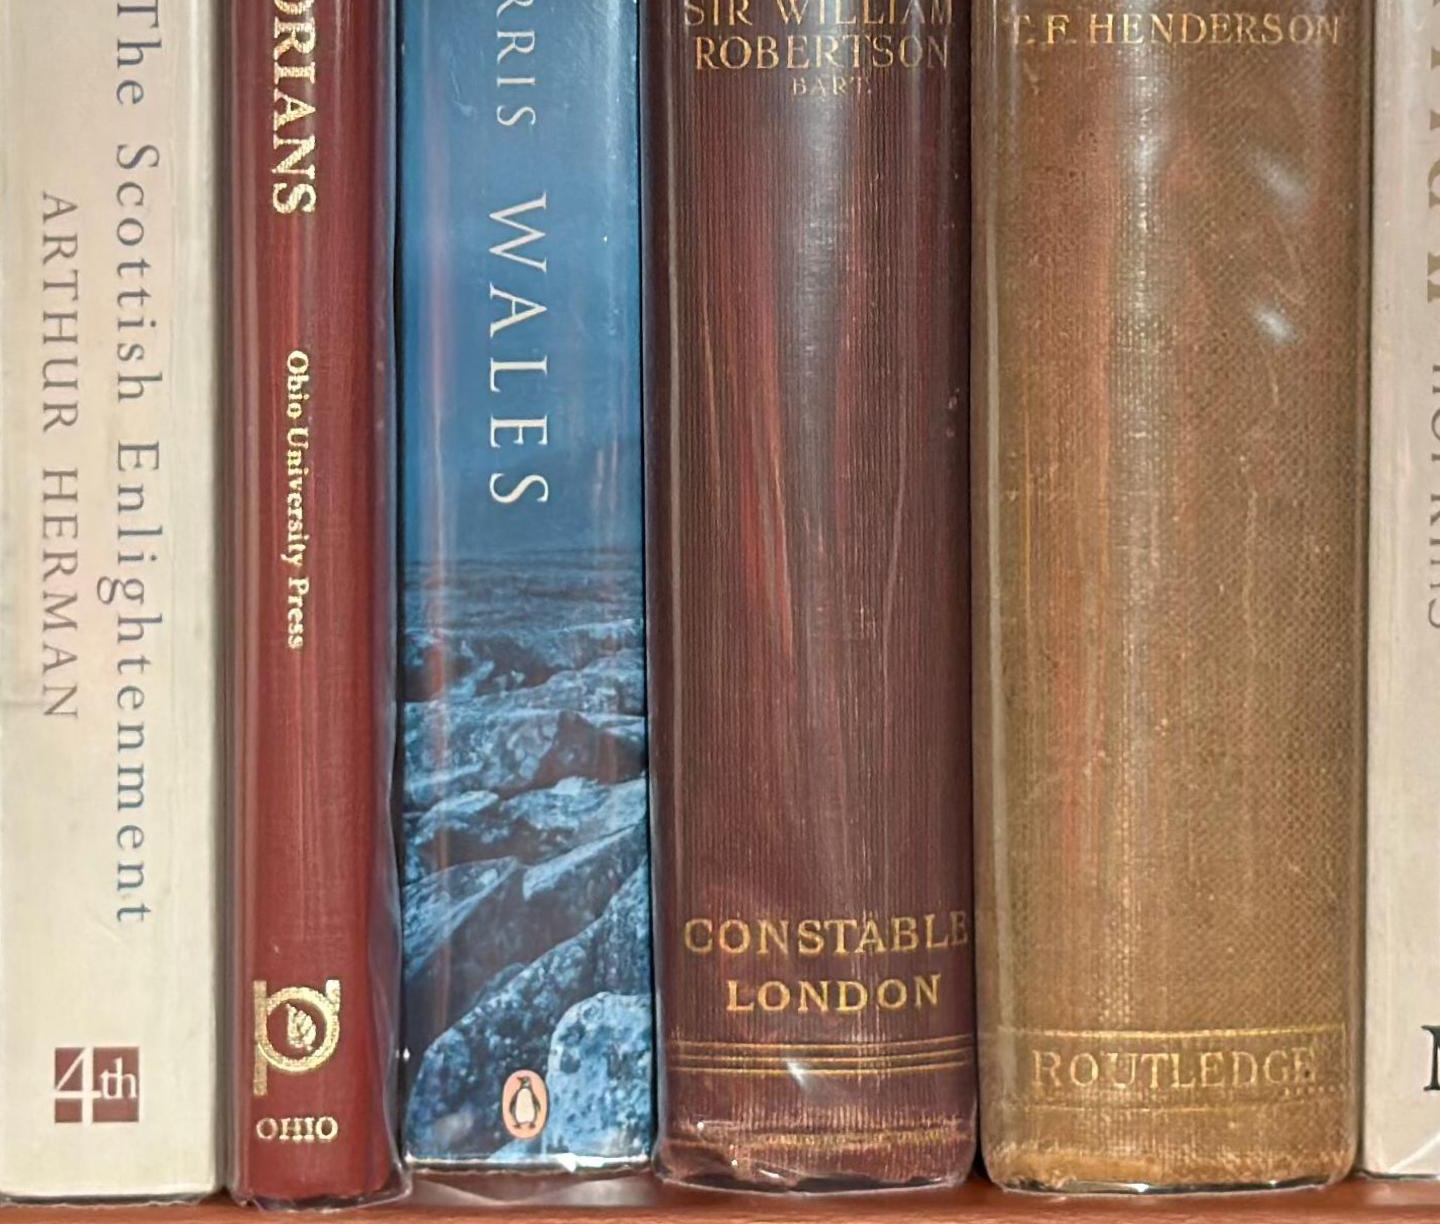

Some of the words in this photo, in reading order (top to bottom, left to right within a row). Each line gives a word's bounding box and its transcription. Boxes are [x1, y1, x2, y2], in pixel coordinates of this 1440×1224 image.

[695, 34, 950, 72] ROBERTSON
[1089, 12, 1341, 46] HENDERSON
[115, 143, 163, 402] Scottish
[41, 190, 79, 434] ARTHUR
[488, 190, 550, 505] WALES
[285, 349, 310, 421] Ohio
[280, 428, 311, 569] University
[41, 467, 79, 721] HERMAN
[286, 575, 310, 651] Press
[96, 439, 165, 924] Enlightenment
[683, 912, 970, 955] CONSTABLE
[727, 972, 942, 1014] LONDON
[55, 1047, 140, 1123] 4th
[1031, 1046, 1319, 1091] ROUTLEDGE
[255, 1116, 338, 1144] OHIO
